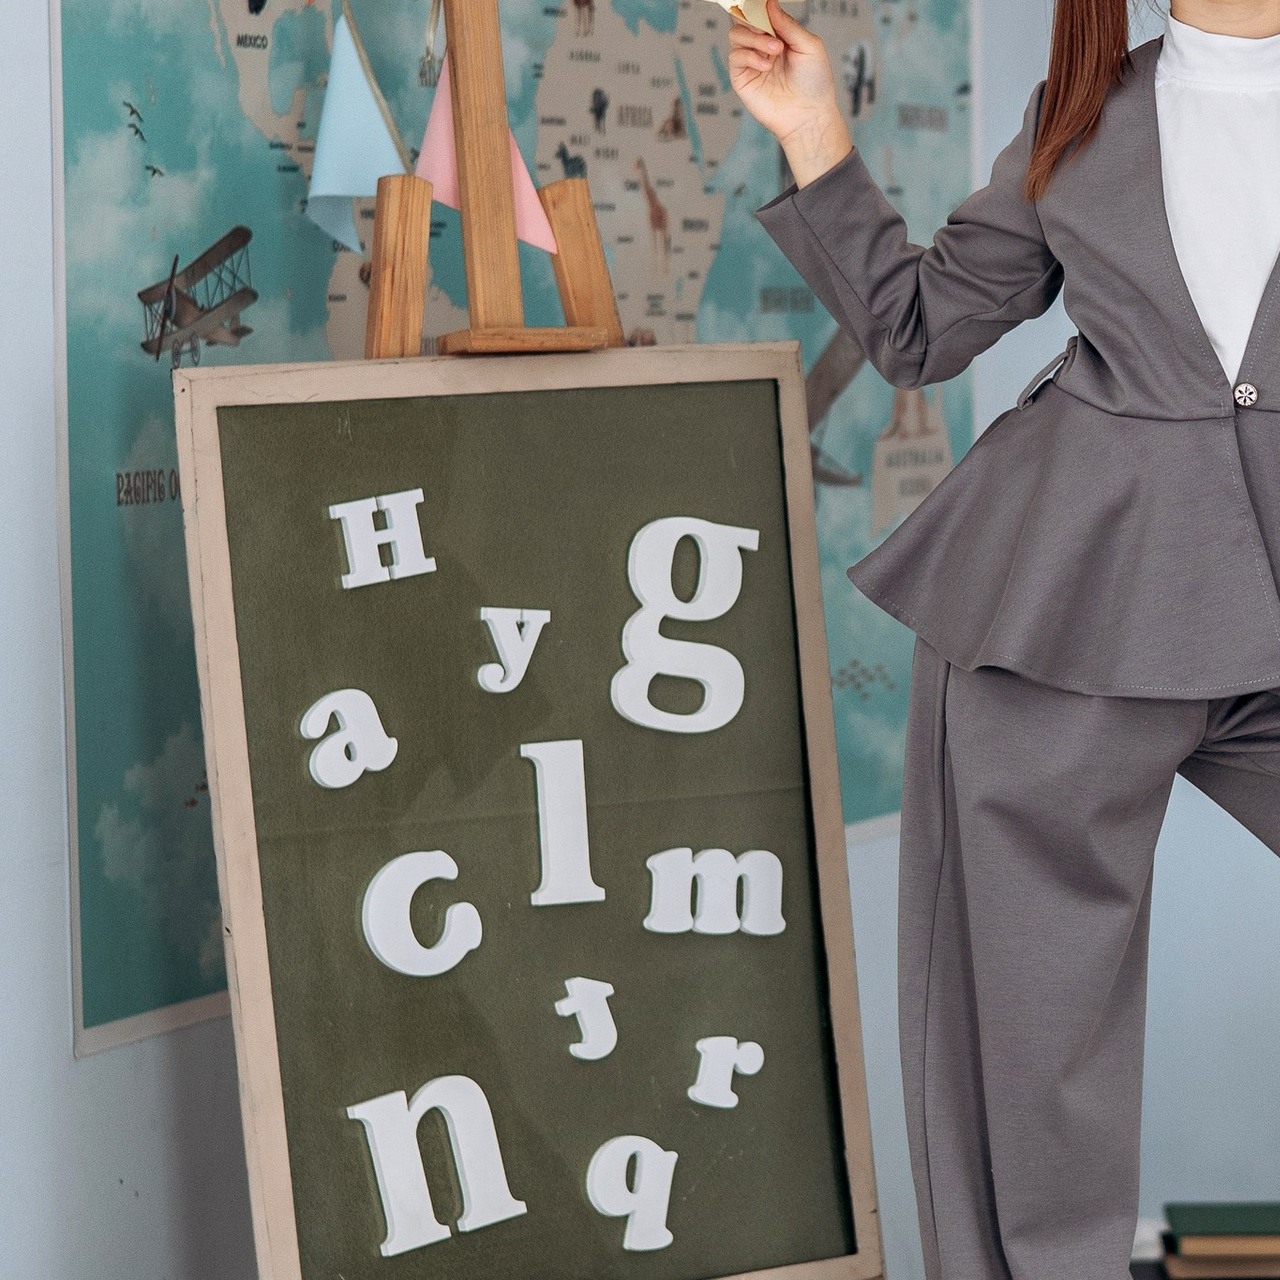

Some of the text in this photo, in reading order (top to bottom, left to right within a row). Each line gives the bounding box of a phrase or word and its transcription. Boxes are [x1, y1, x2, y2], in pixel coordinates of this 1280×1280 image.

[236, 33, 269, 50] MEXICO
[328, 487, 437, 589] H
[476, 606, 552, 693] y
[610, 515, 760, 734] g
[299, 688, 399, 788] a
[642, 846, 787, 936] m
[687, 1035, 765, 1108] r
[346, 1074, 528, 1257] n
